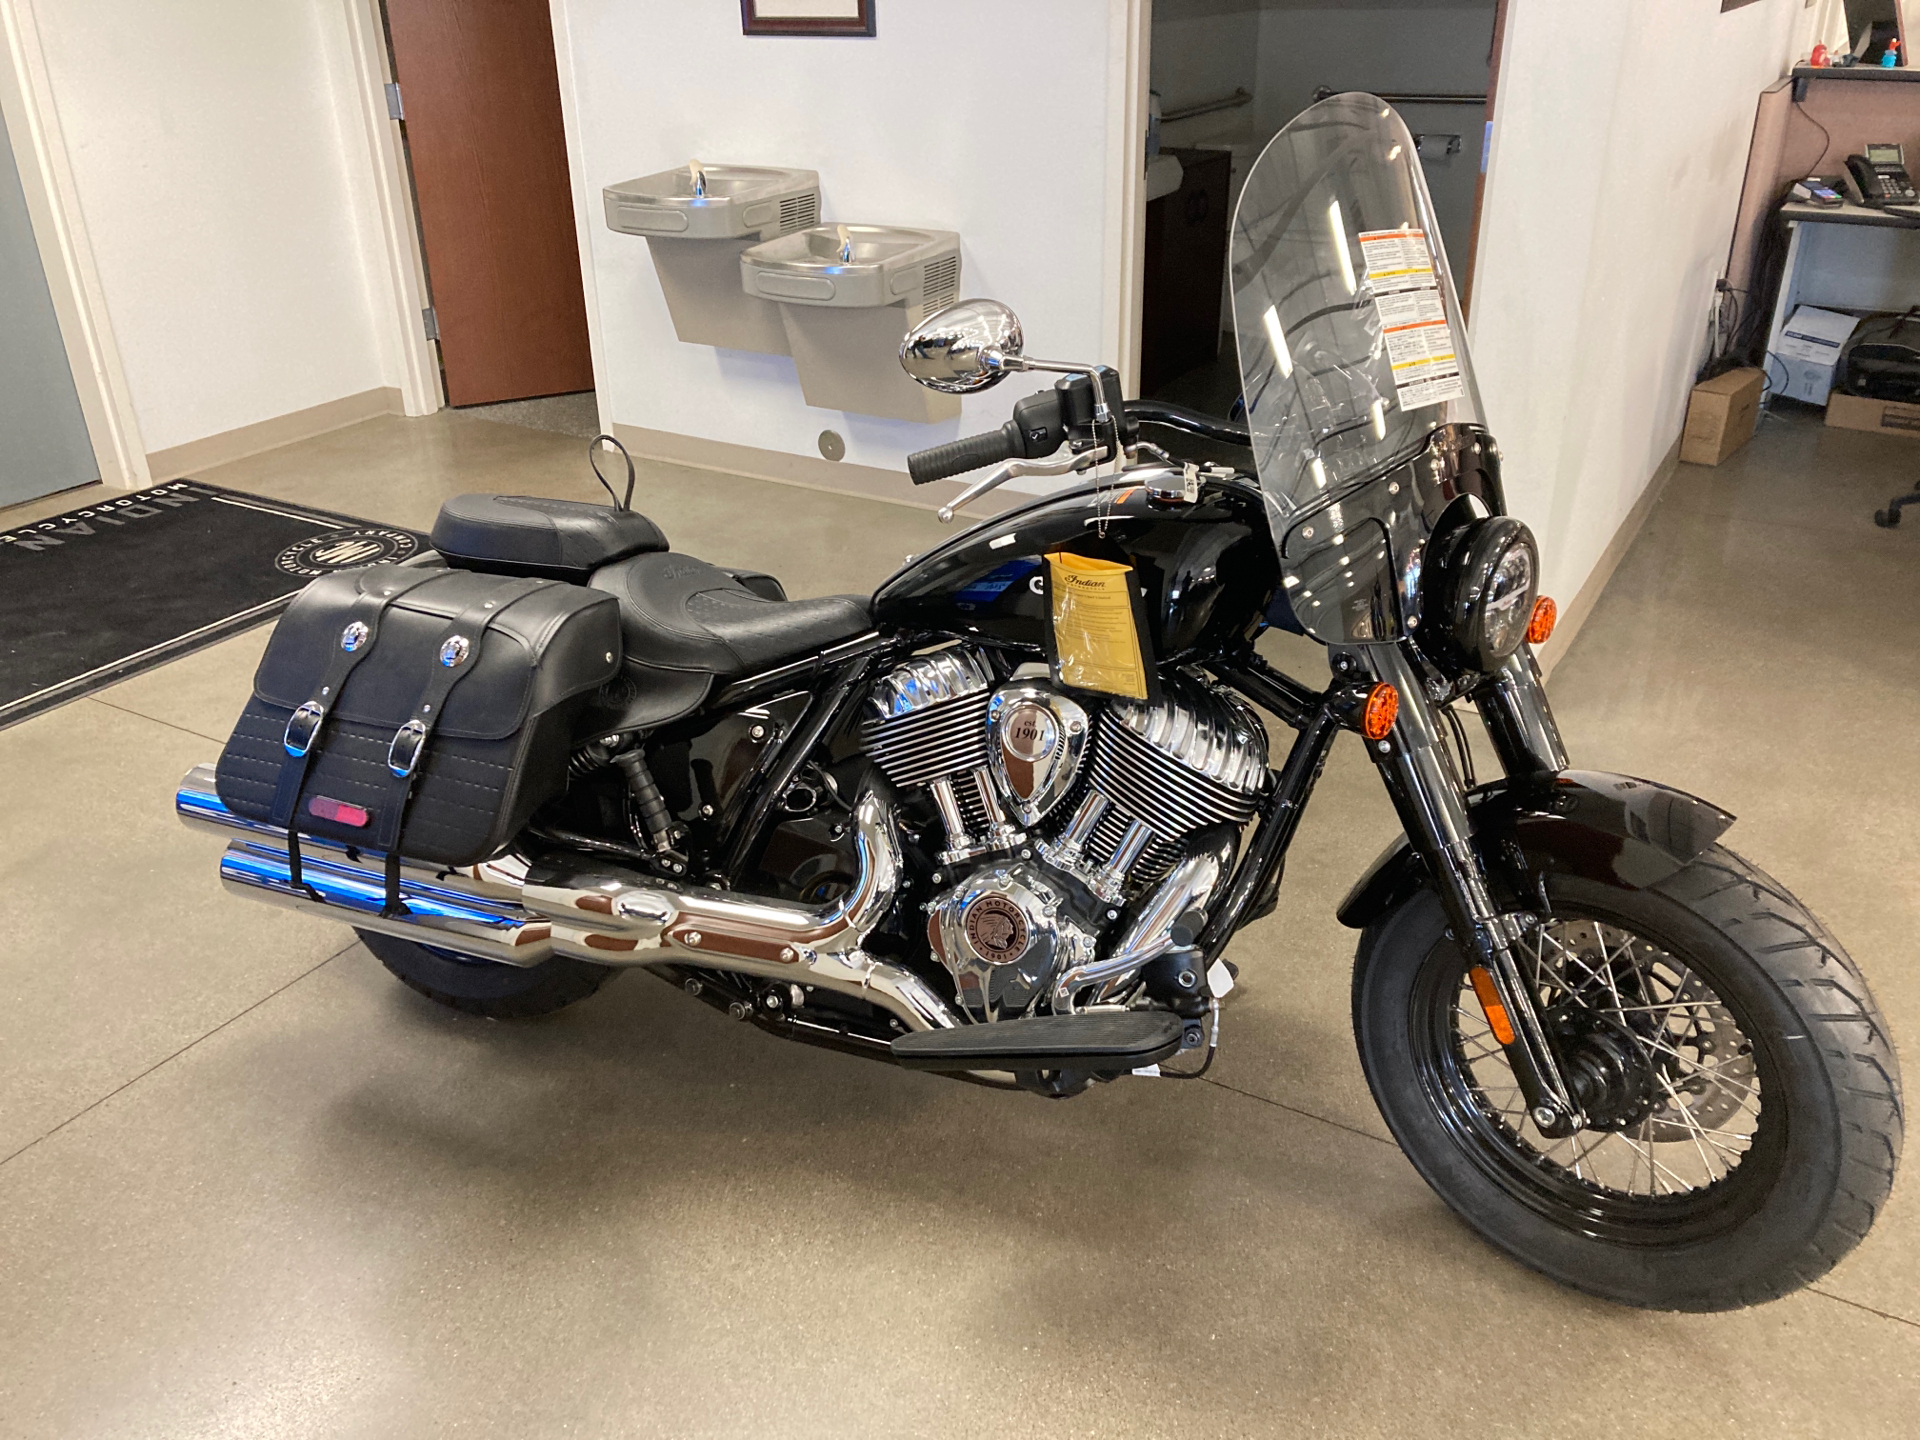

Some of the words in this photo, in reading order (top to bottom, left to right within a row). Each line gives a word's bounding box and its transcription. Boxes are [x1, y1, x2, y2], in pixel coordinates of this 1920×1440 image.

[0, 482, 189, 543] MOTORCYCLE
[13, 486, 217, 551] INDIAN
[352, 529, 413, 549] COMPANY
[280, 537, 323, 576] MOTORCYCLE
[1064, 574, 1106, 588] Indian
[1014, 726, 1046, 742] 1901
[1023, 719, 1037, 728] est.
[969, 907, 983, 945] INDIAN
[985, 900, 1027, 952] MOTORCYCLE
